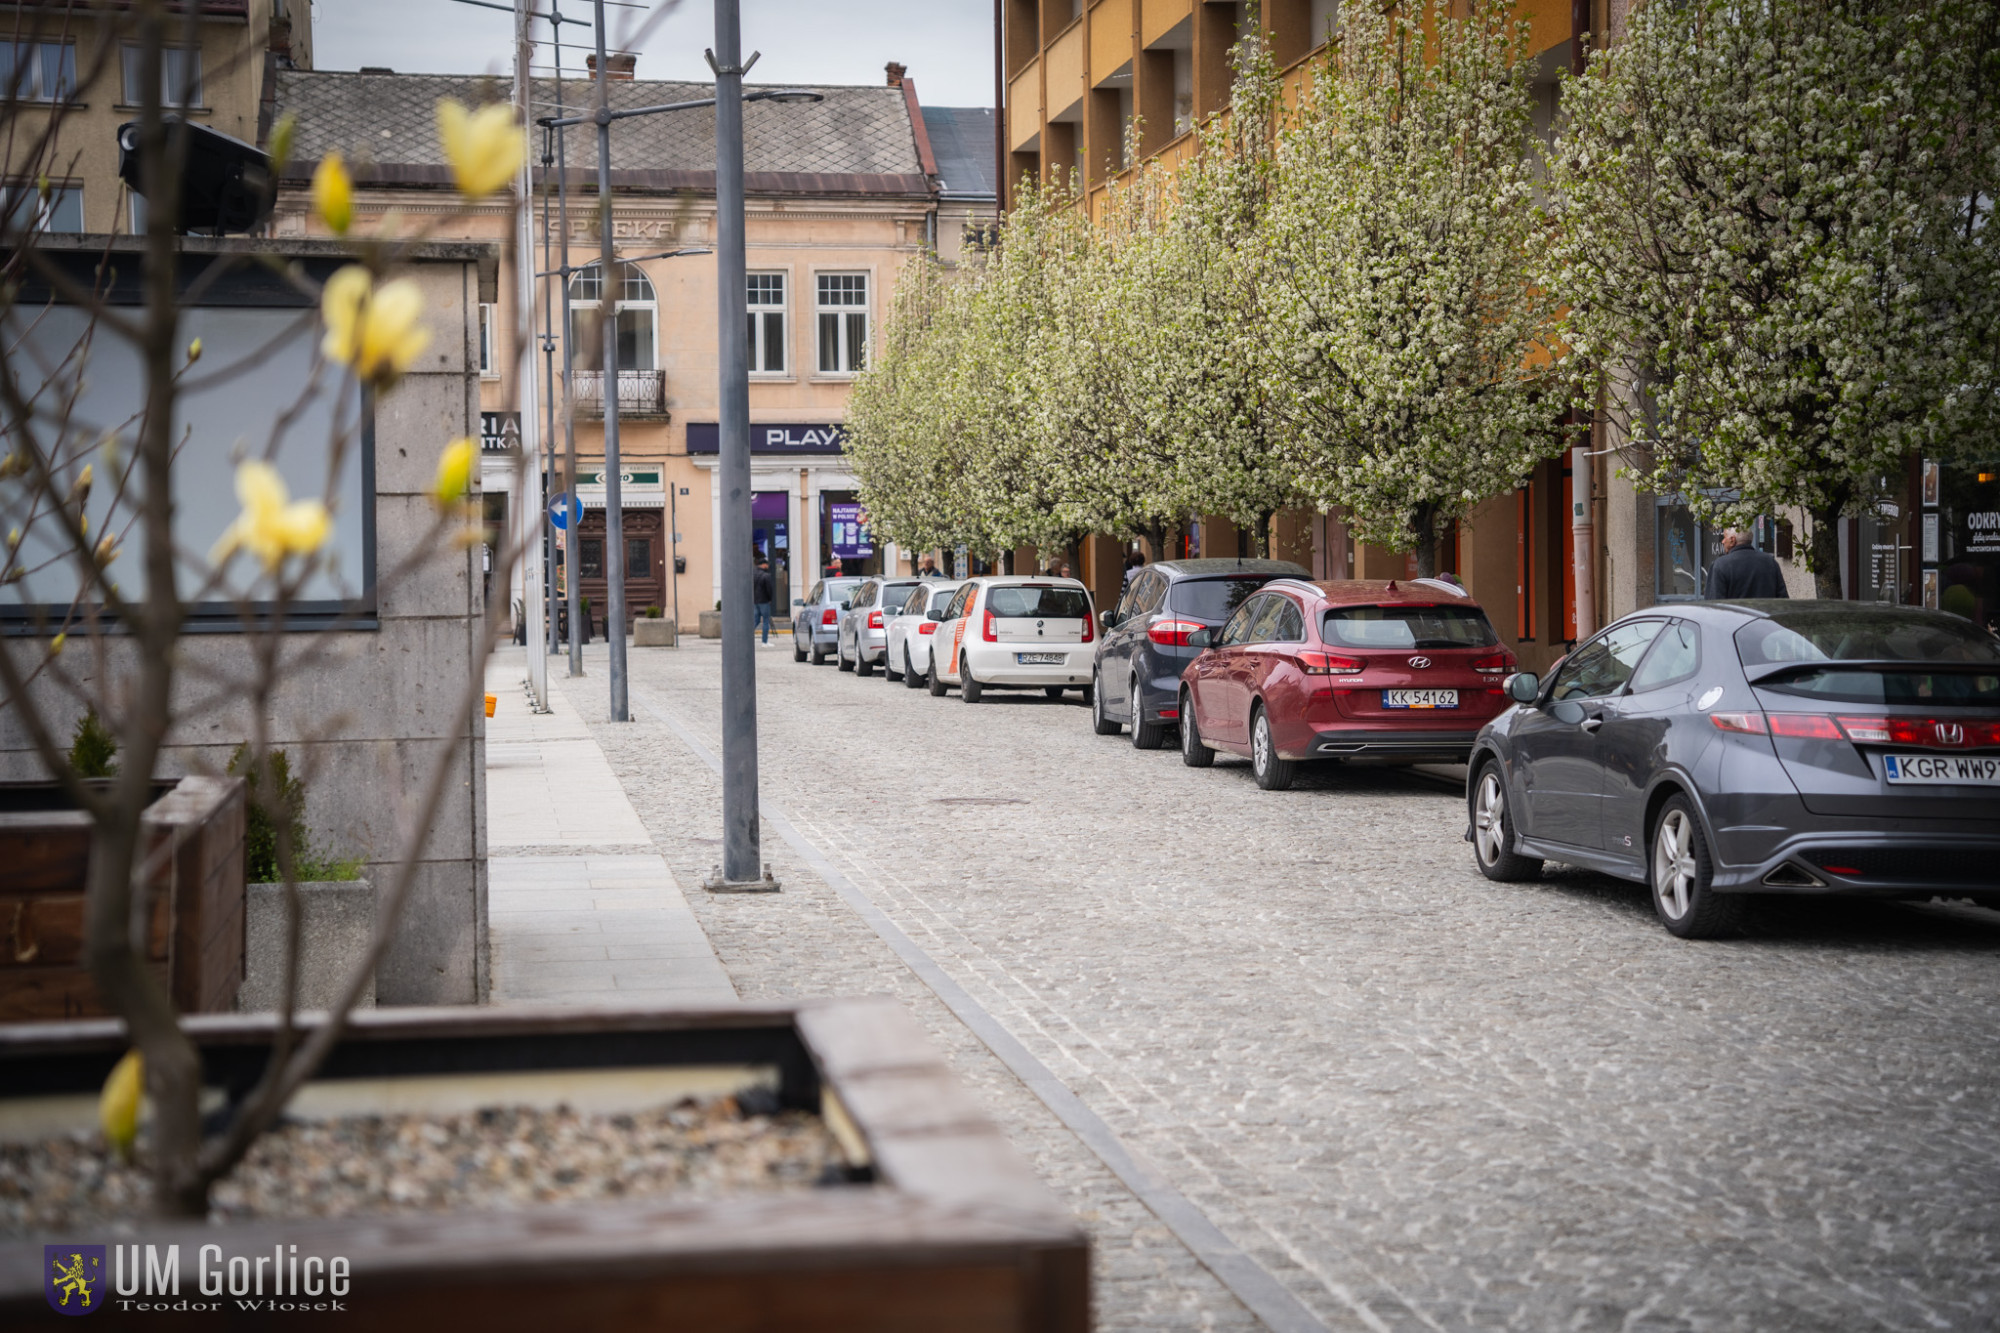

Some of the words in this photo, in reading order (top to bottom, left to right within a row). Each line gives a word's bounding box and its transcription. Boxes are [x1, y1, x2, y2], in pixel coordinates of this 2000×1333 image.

[547, 220, 676, 239] APEKA
[766, 429, 839, 445] PLAY
[1391, 691, 1408, 704] KK
[1414, 691, 1455, 704] 54162
[1900, 758, 1950, 778] KGR
[1954, 759, 2000, 779] WW9
